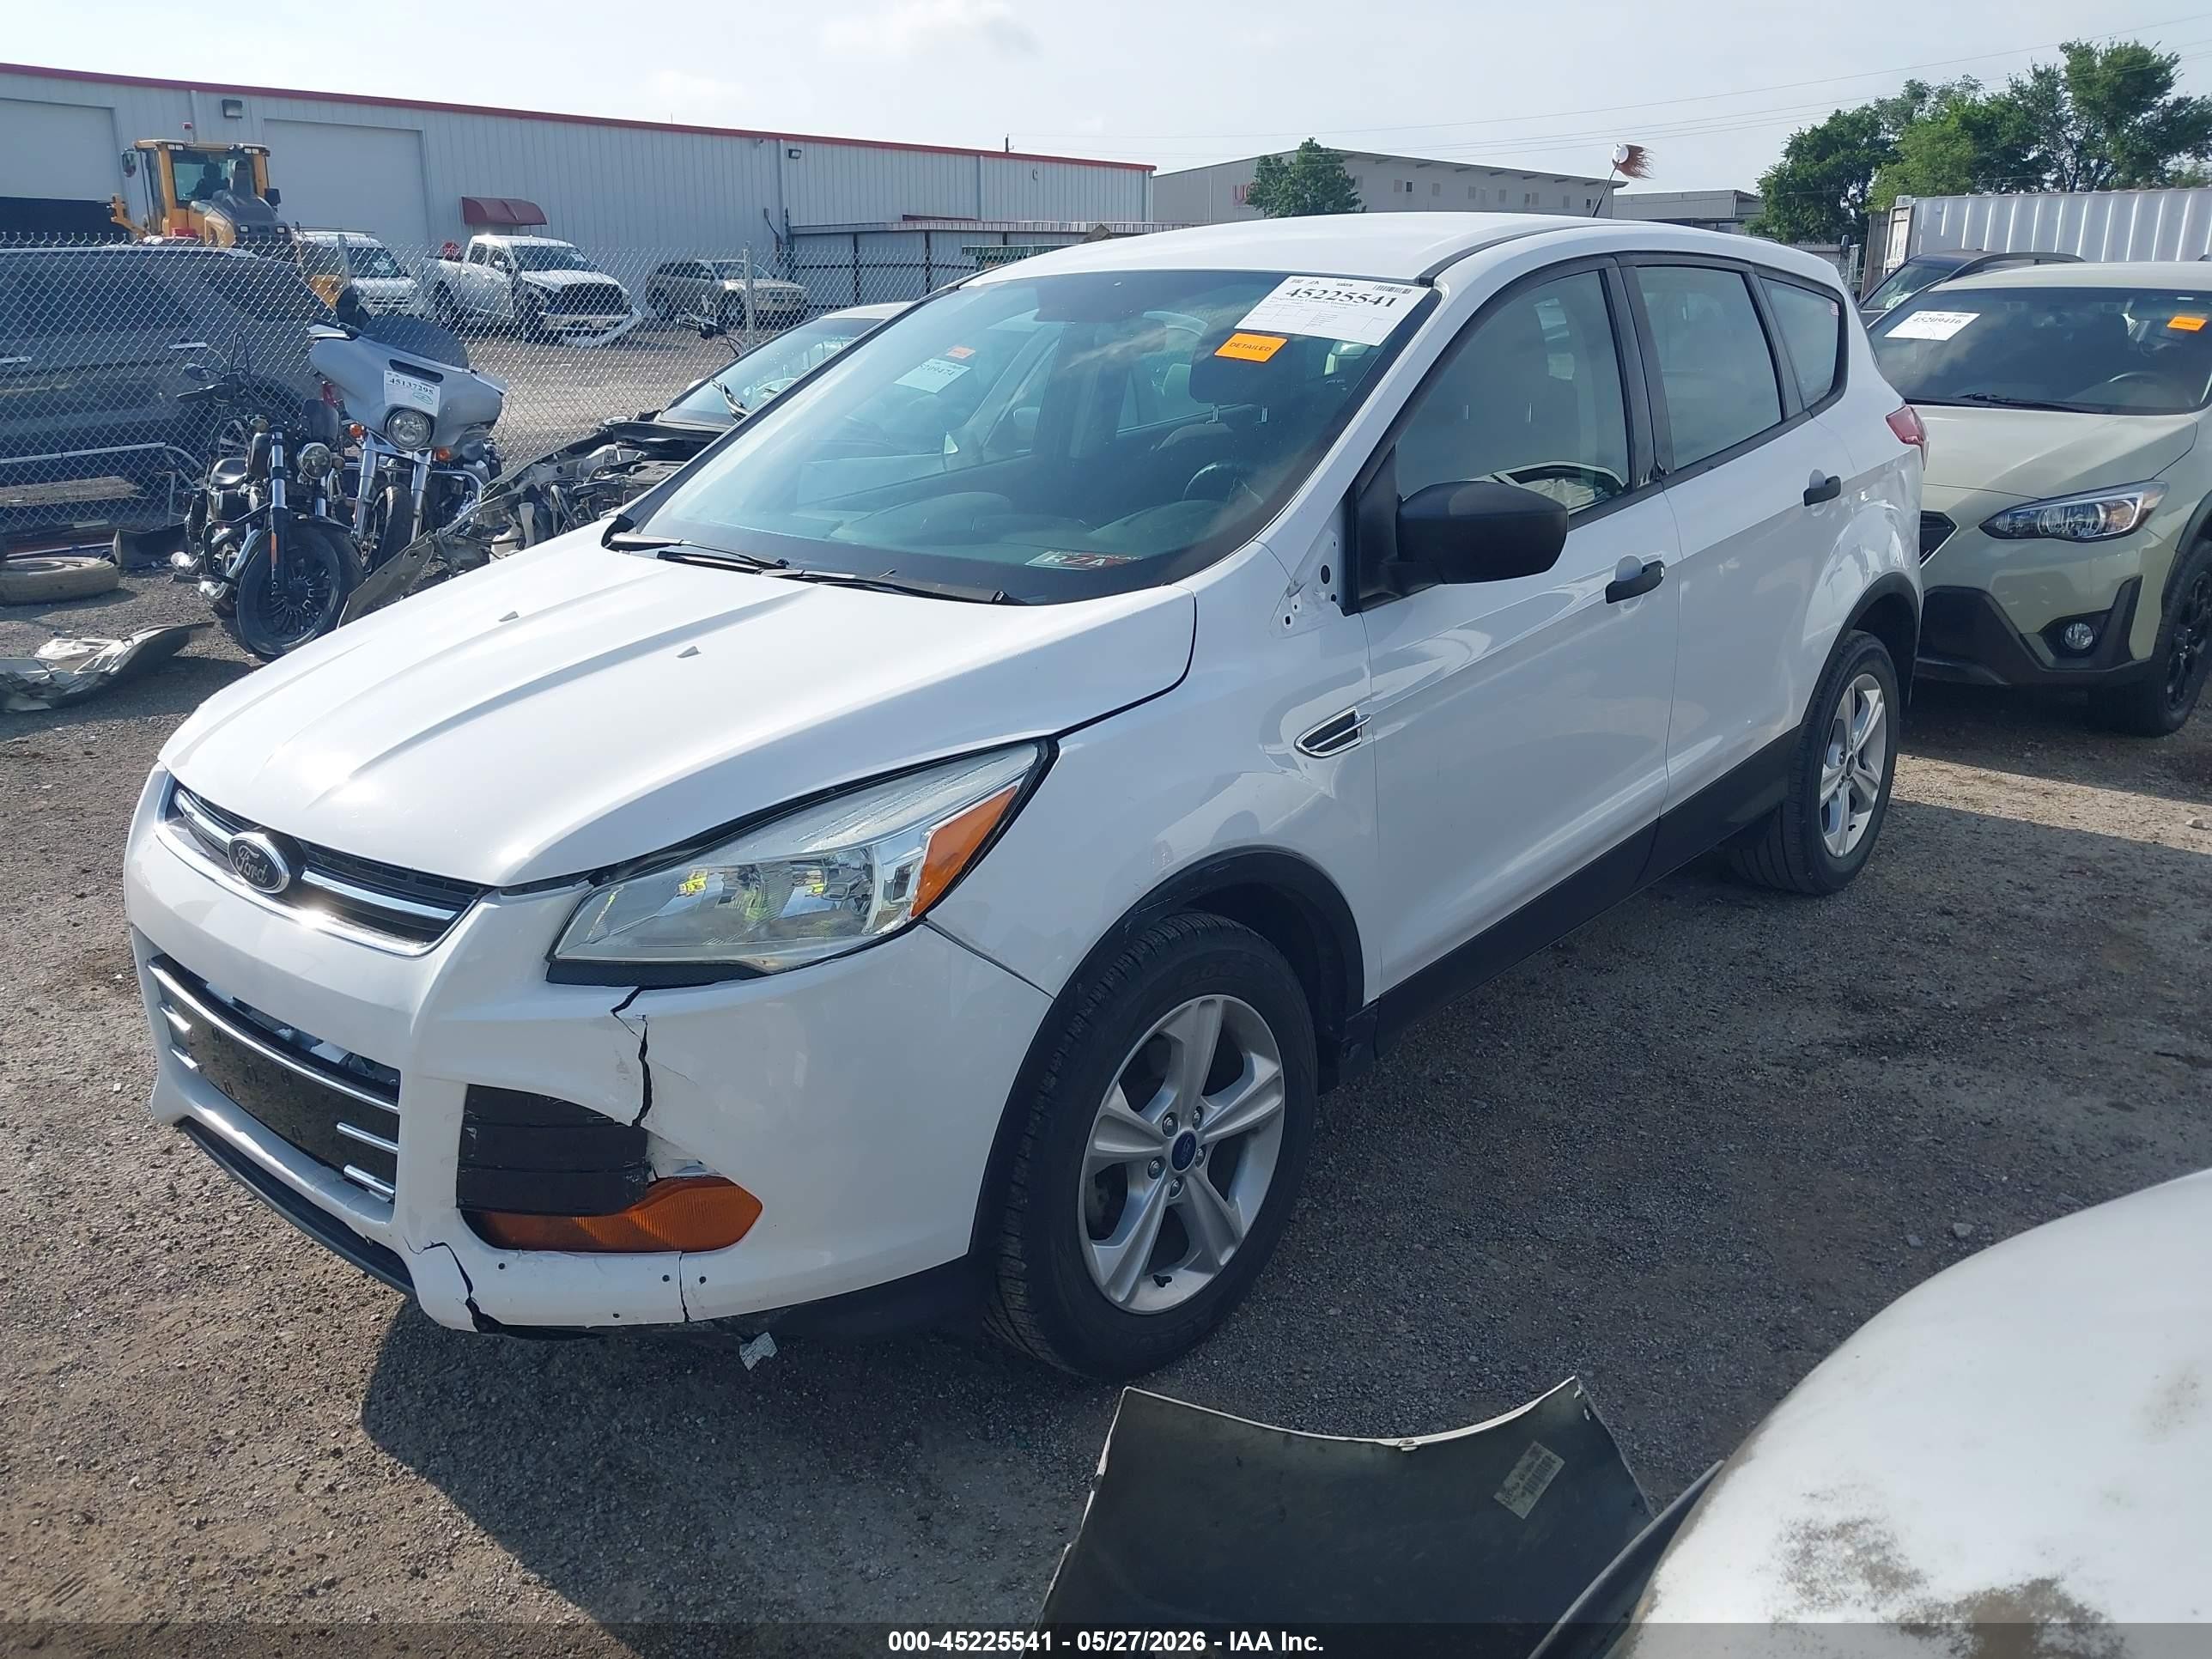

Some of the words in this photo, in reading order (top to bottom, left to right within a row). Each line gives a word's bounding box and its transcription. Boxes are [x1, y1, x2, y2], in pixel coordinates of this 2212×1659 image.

[1285, 288, 1398, 307] 45225541
[1230, 342, 1272, 352] DETAILED
[389, 378, 434, 395] 45137295
[235, 845, 268, 884] Ford
